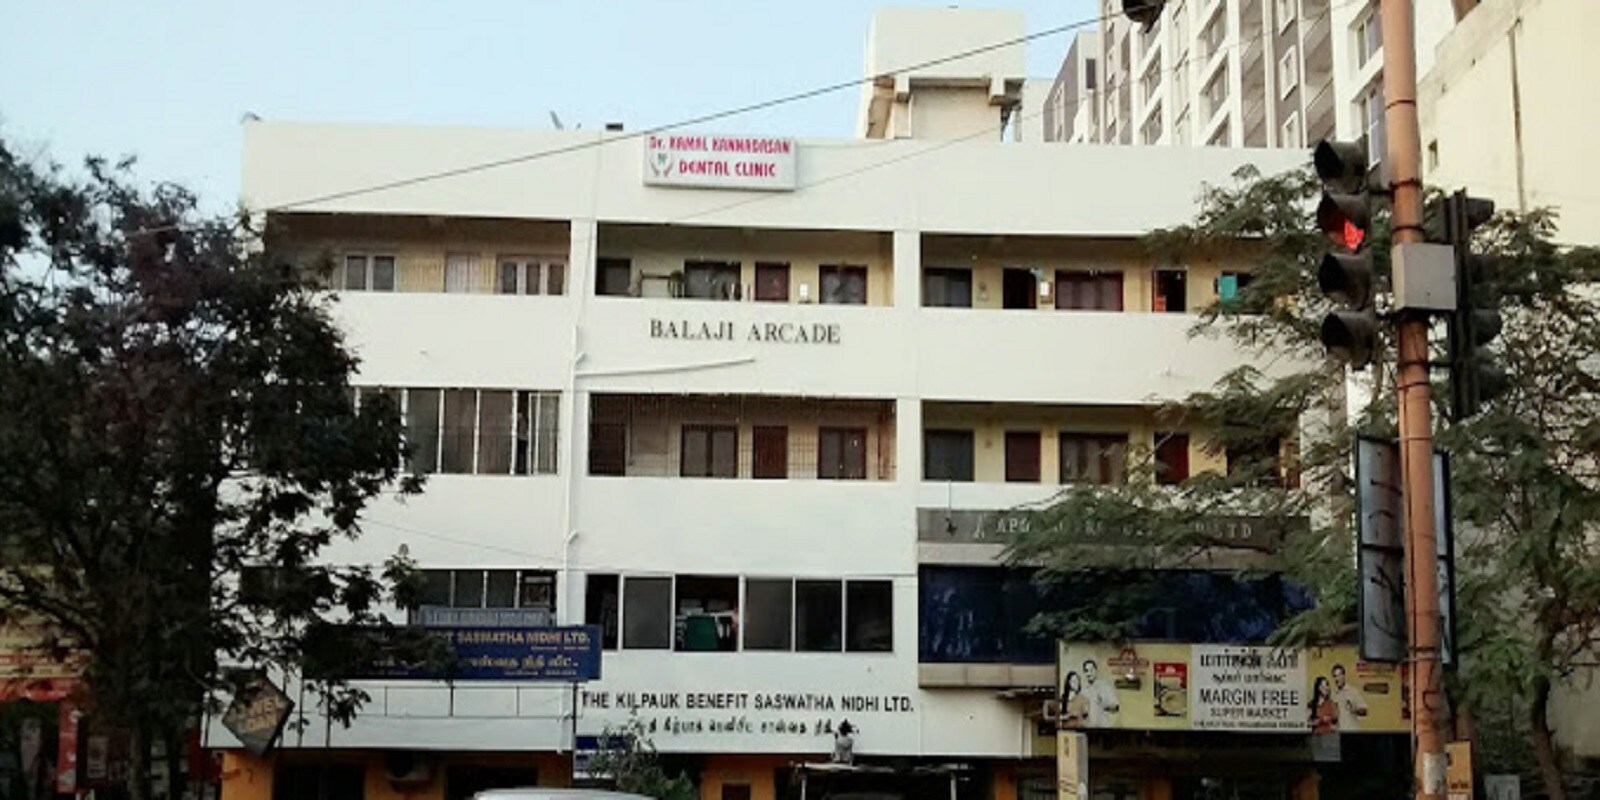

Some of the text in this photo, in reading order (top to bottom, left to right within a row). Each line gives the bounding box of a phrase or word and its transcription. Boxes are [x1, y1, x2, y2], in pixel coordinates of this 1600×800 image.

[649, 136, 791, 154] Dr. KAMAL KANNADASAN
[679, 160, 776, 177] DENTAL CLINIC
[650, 319, 841, 344] BALAJI ARCADE
[563, 631, 591, 644] LTD.
[582, 691, 914, 712] THE KILPAUK BENEFIT SASWATHA NIDHI LTD.
[1200, 688, 1299, 706] MARGIN FREE
[1210, 707, 1288, 719] SUPER MARKET
